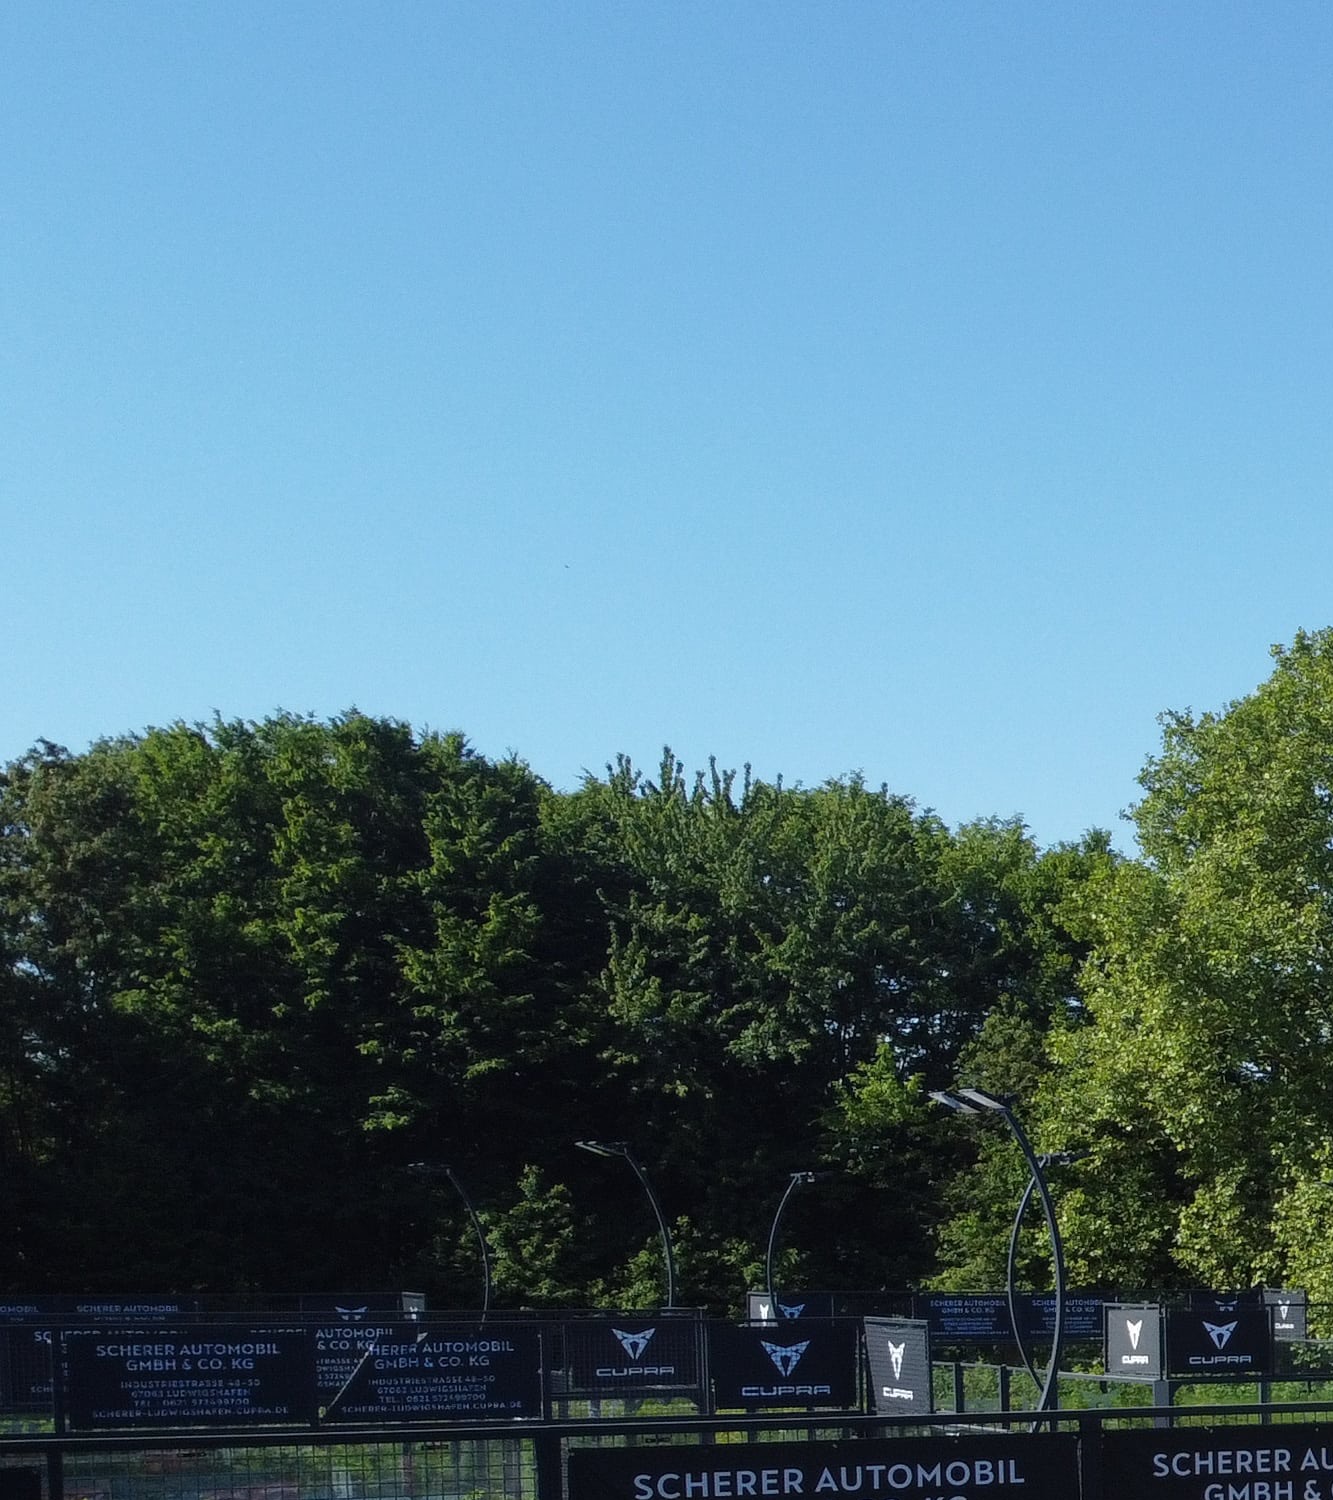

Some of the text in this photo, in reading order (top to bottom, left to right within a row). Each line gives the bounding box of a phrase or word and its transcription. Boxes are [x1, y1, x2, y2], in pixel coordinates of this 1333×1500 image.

[96, 1343, 280, 1357] SCHERER AUTOMOBIL
[422, 1340, 514, 1354] AUTOMOBIL
[126, 1358, 255, 1372] GMBH & CO. KG
[374, 1355, 490, 1370] GMBH & CO. KG
[1122, 1355, 1149, 1365] CUPRA
[1188, 1354, 1252, 1365] CUPRA
[595, 1366, 674, 1378] CUPRA
[741, 1384, 832, 1398] CUPRA
[882, 1387, 913, 1400] CUPRA
[1152, 1447, 1291, 1479] SCHERER
[633, 1459, 1025, 1500] SCHERER AUTOMOBIL
